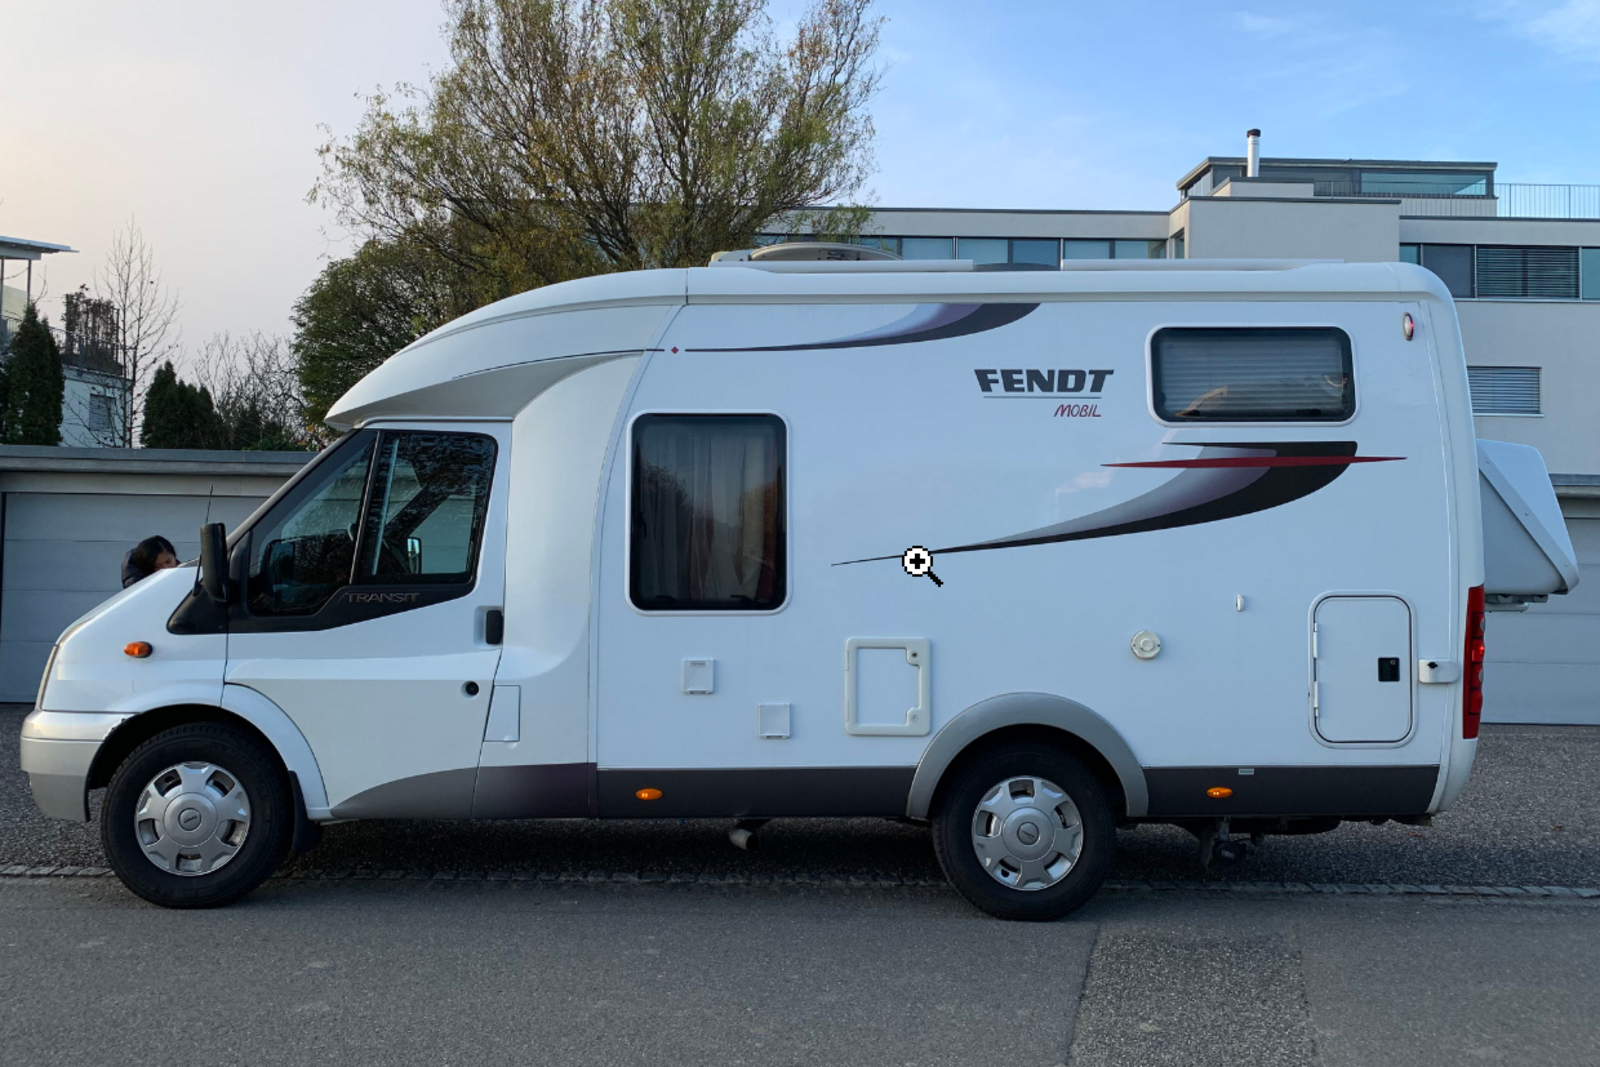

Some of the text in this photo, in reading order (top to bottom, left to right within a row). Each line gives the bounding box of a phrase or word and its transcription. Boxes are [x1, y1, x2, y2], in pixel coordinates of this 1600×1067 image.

[974, 368, 1115, 393] FENDT
[1053, 404, 1102, 418] MOBIL
[346, 592, 420, 604] TRANSIT
